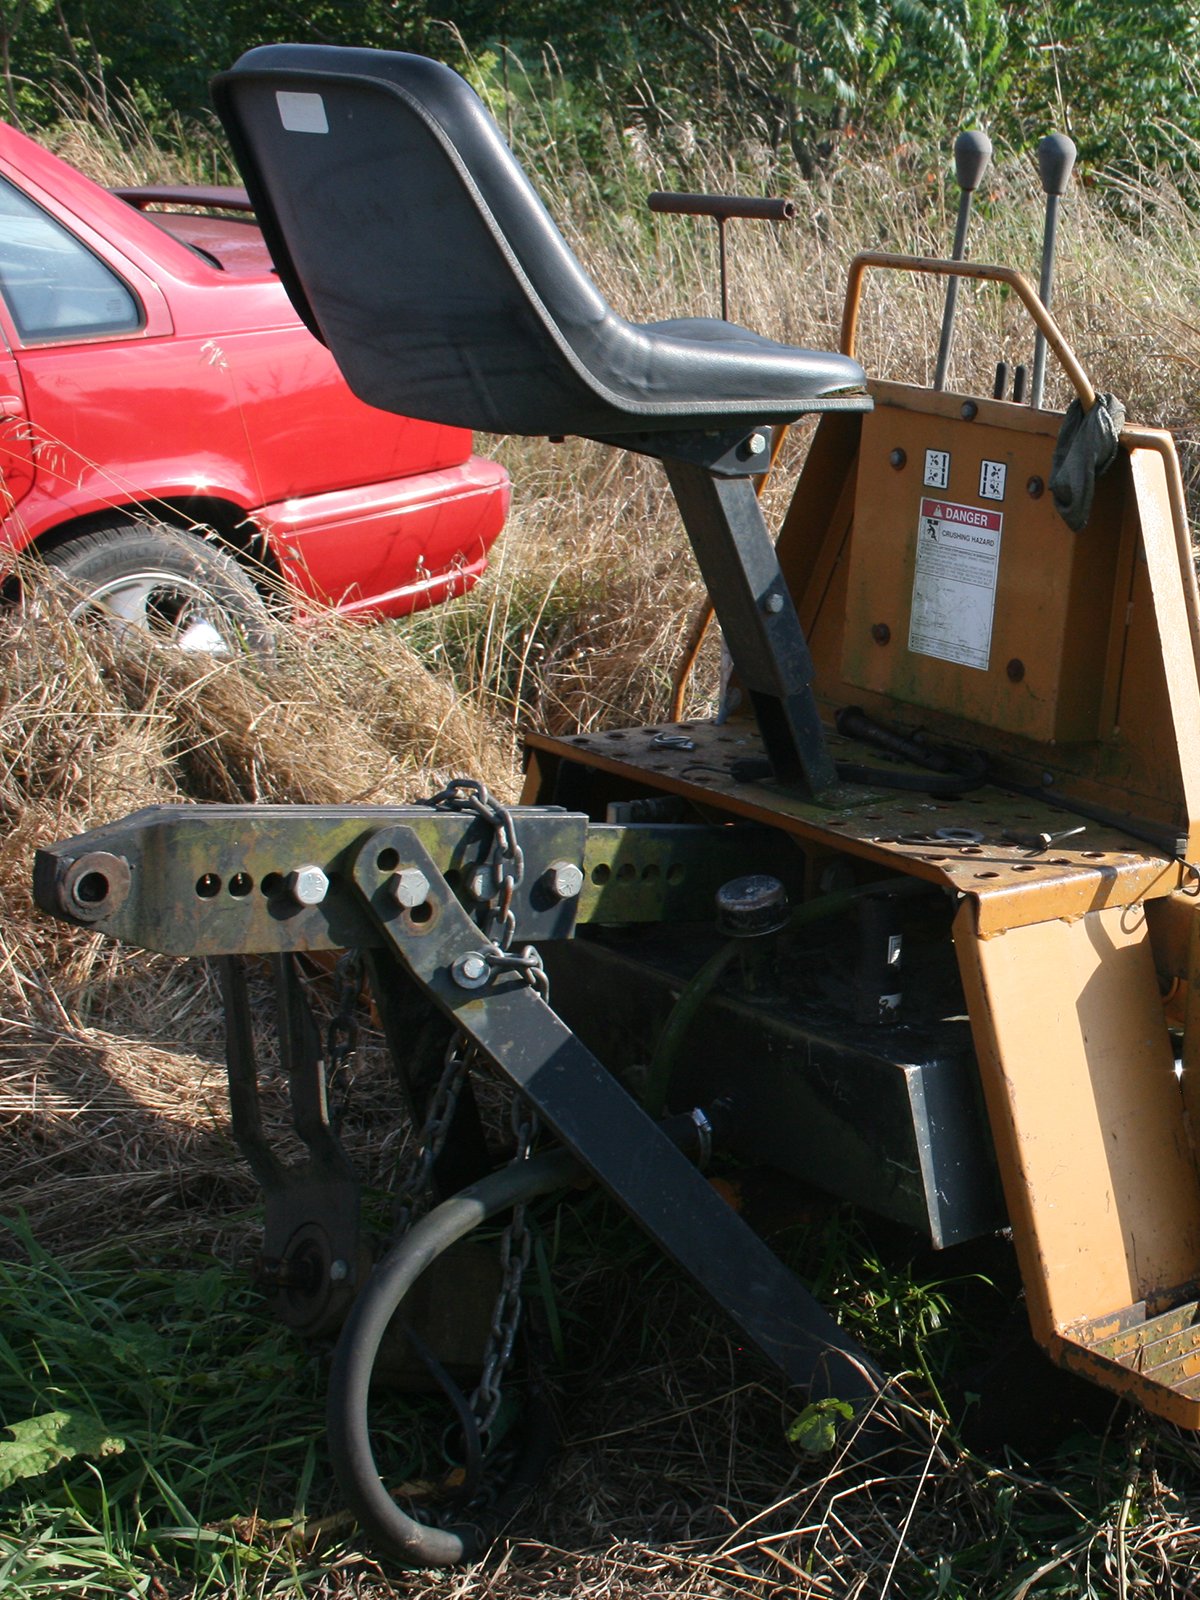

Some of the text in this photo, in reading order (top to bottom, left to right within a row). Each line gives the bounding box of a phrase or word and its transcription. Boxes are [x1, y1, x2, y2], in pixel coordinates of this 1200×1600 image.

[945, 508, 988, 526] DANGER
[941, 529, 995, 547] CRUSHING HAZARD
